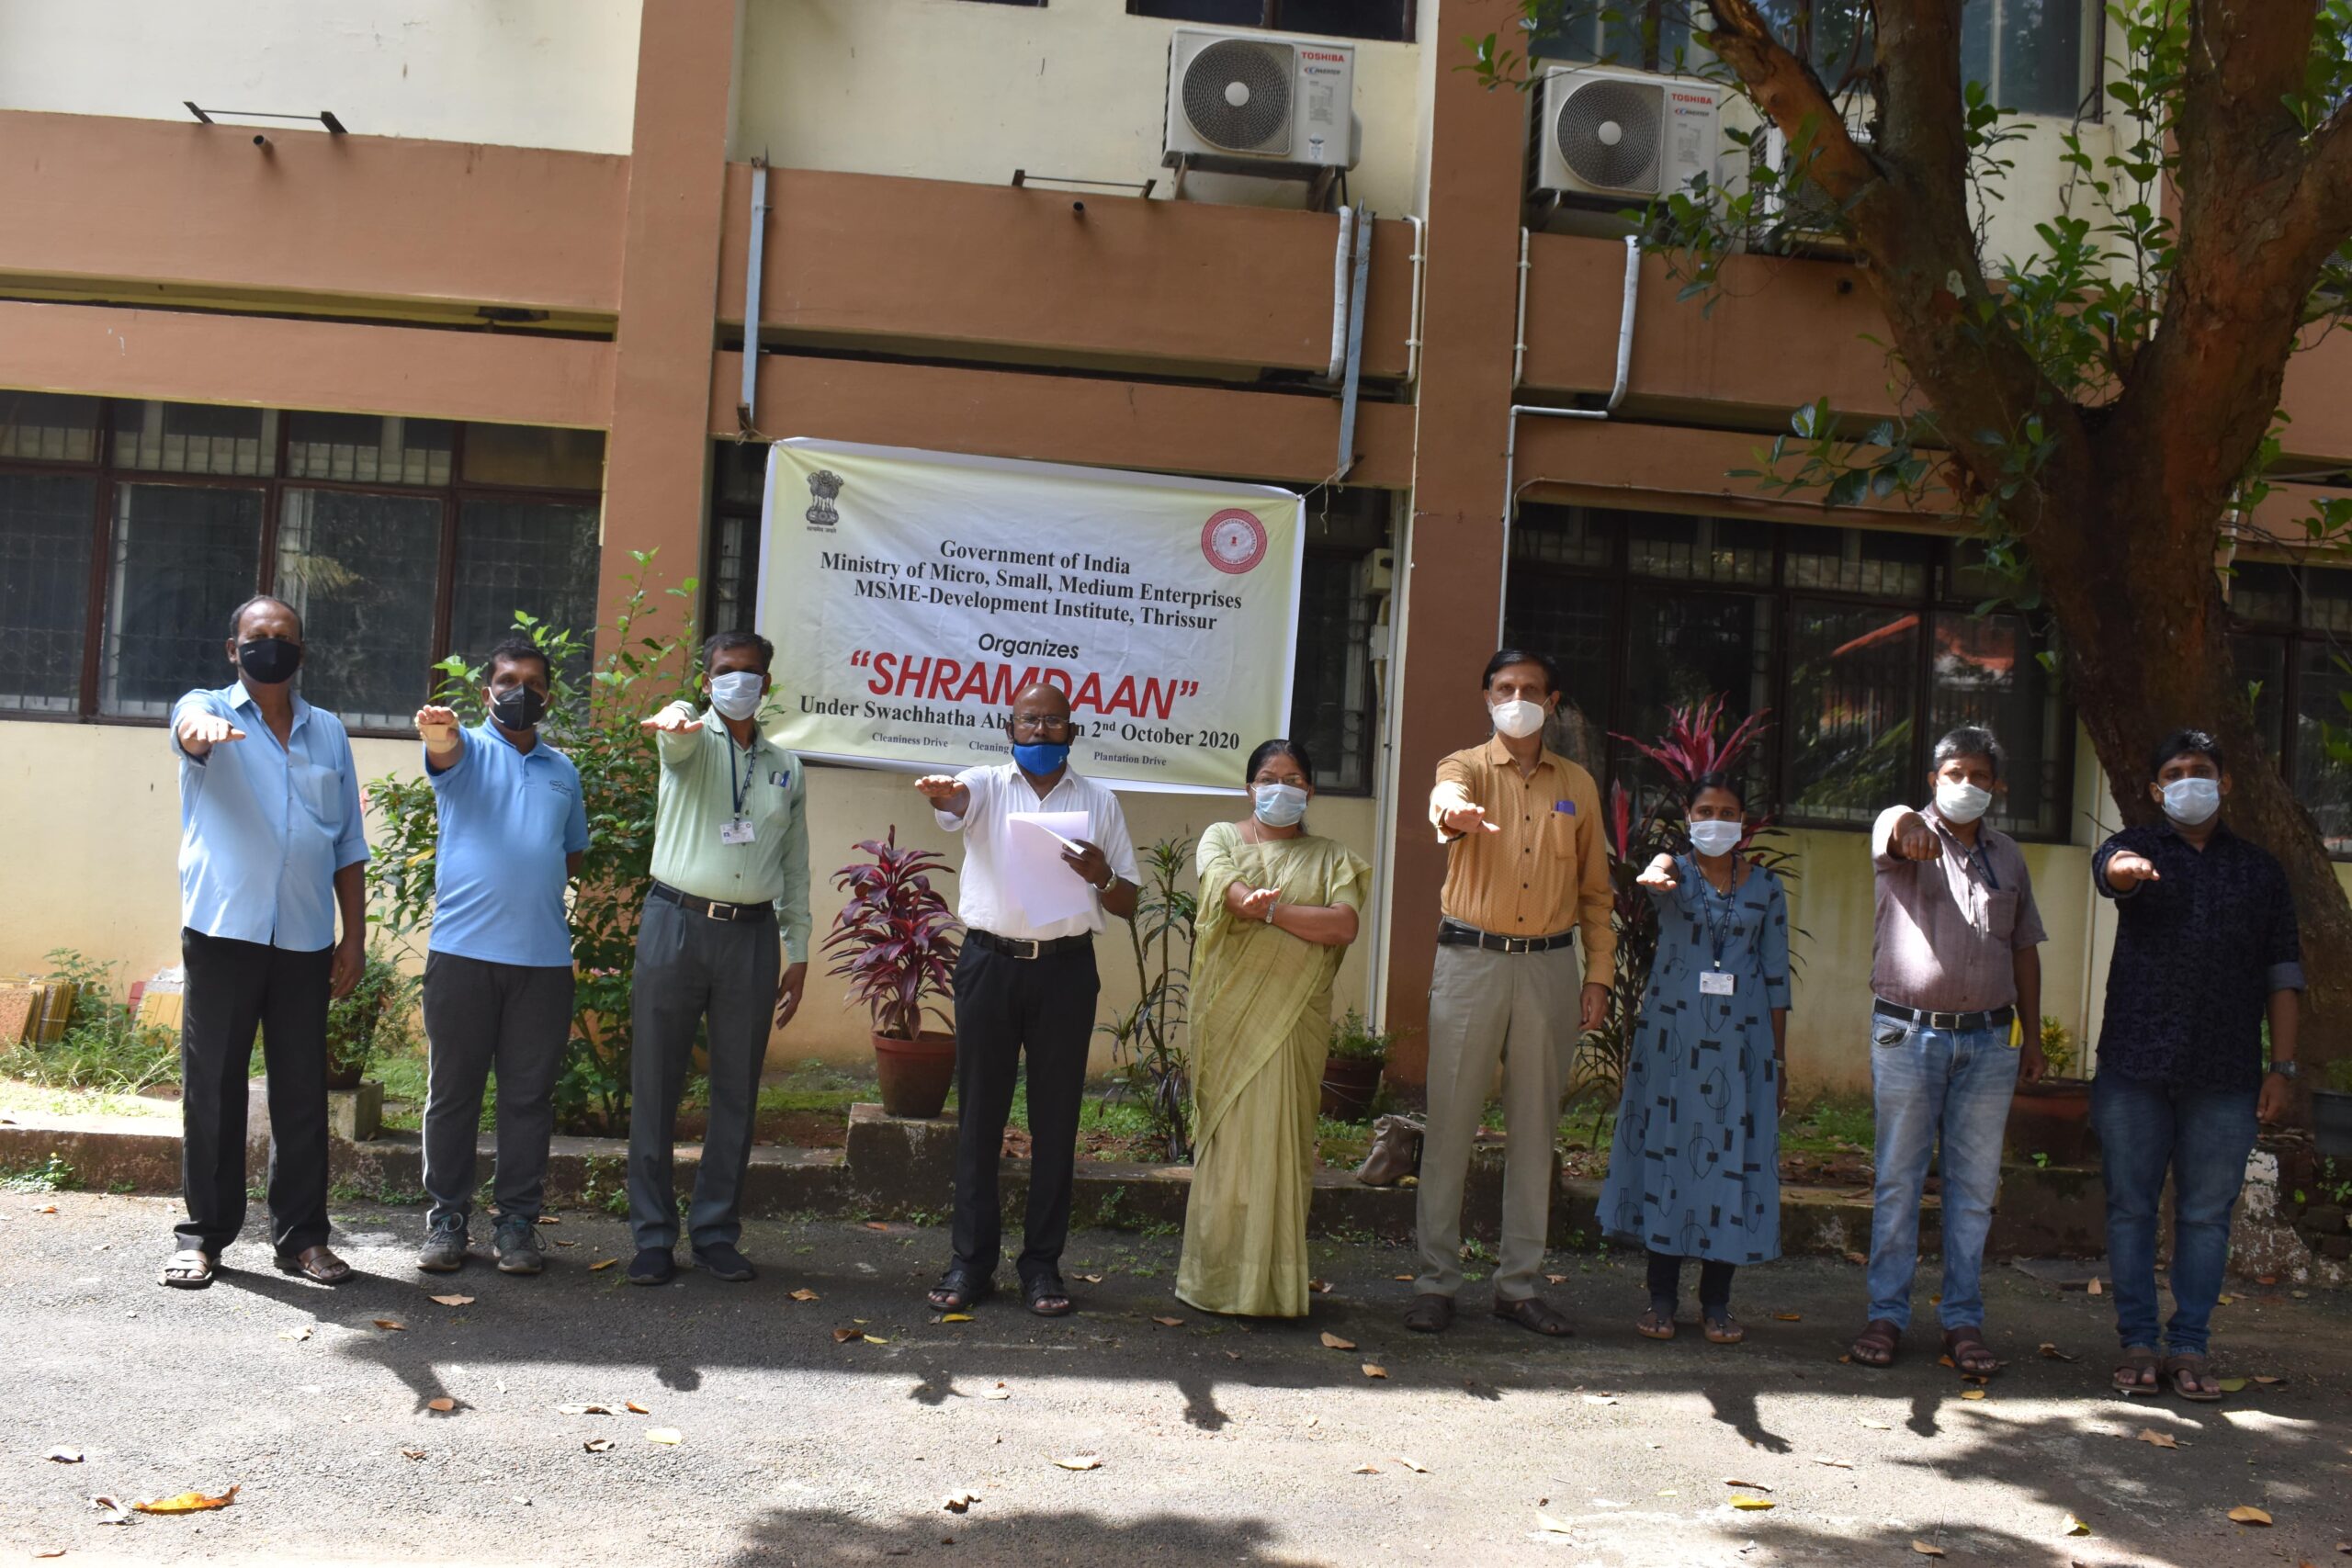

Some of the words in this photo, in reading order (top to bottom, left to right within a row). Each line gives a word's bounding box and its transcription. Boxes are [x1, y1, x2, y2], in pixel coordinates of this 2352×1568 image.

[1301, 51, 1345, 62] TOSHIBA
[1671, 93, 1713, 104] TOSHIBA
[940, 539, 1056, 568] Government
[1060, 553, 1080, 569] of
[1084, 553, 1130, 575] India
[820, 551, 900, 581] Ministry
[906, 562, 926, 579] of
[930, 562, 990, 588] Micro,
[996, 569, 1053, 593] Small,
[1058, 575, 1134, 599] Medium
[1139, 582, 1242, 609] Enterprises
[854, 579, 1048, 615] MSME-Development
[1054, 598, 1135, 626] Institute,
[1140, 606, 1217, 630] Thrissur
[978, 633, 1080, 660] Organizes
[800, 694, 859, 716] Under
[864, 701, 976, 728] Swachhatha
[1091, 721, 1116, 739] 2nd
[1121, 724, 1194, 746] October
[1198, 730, 1240, 750] 2020
[872, 731, 921, 746] Cleaniness
[922, 737, 949, 748] Drive
[968, 740, 1010, 755] Cleaning
[1093, 751, 1140, 764] Plantation
[1142, 755, 1168, 767] Drive
